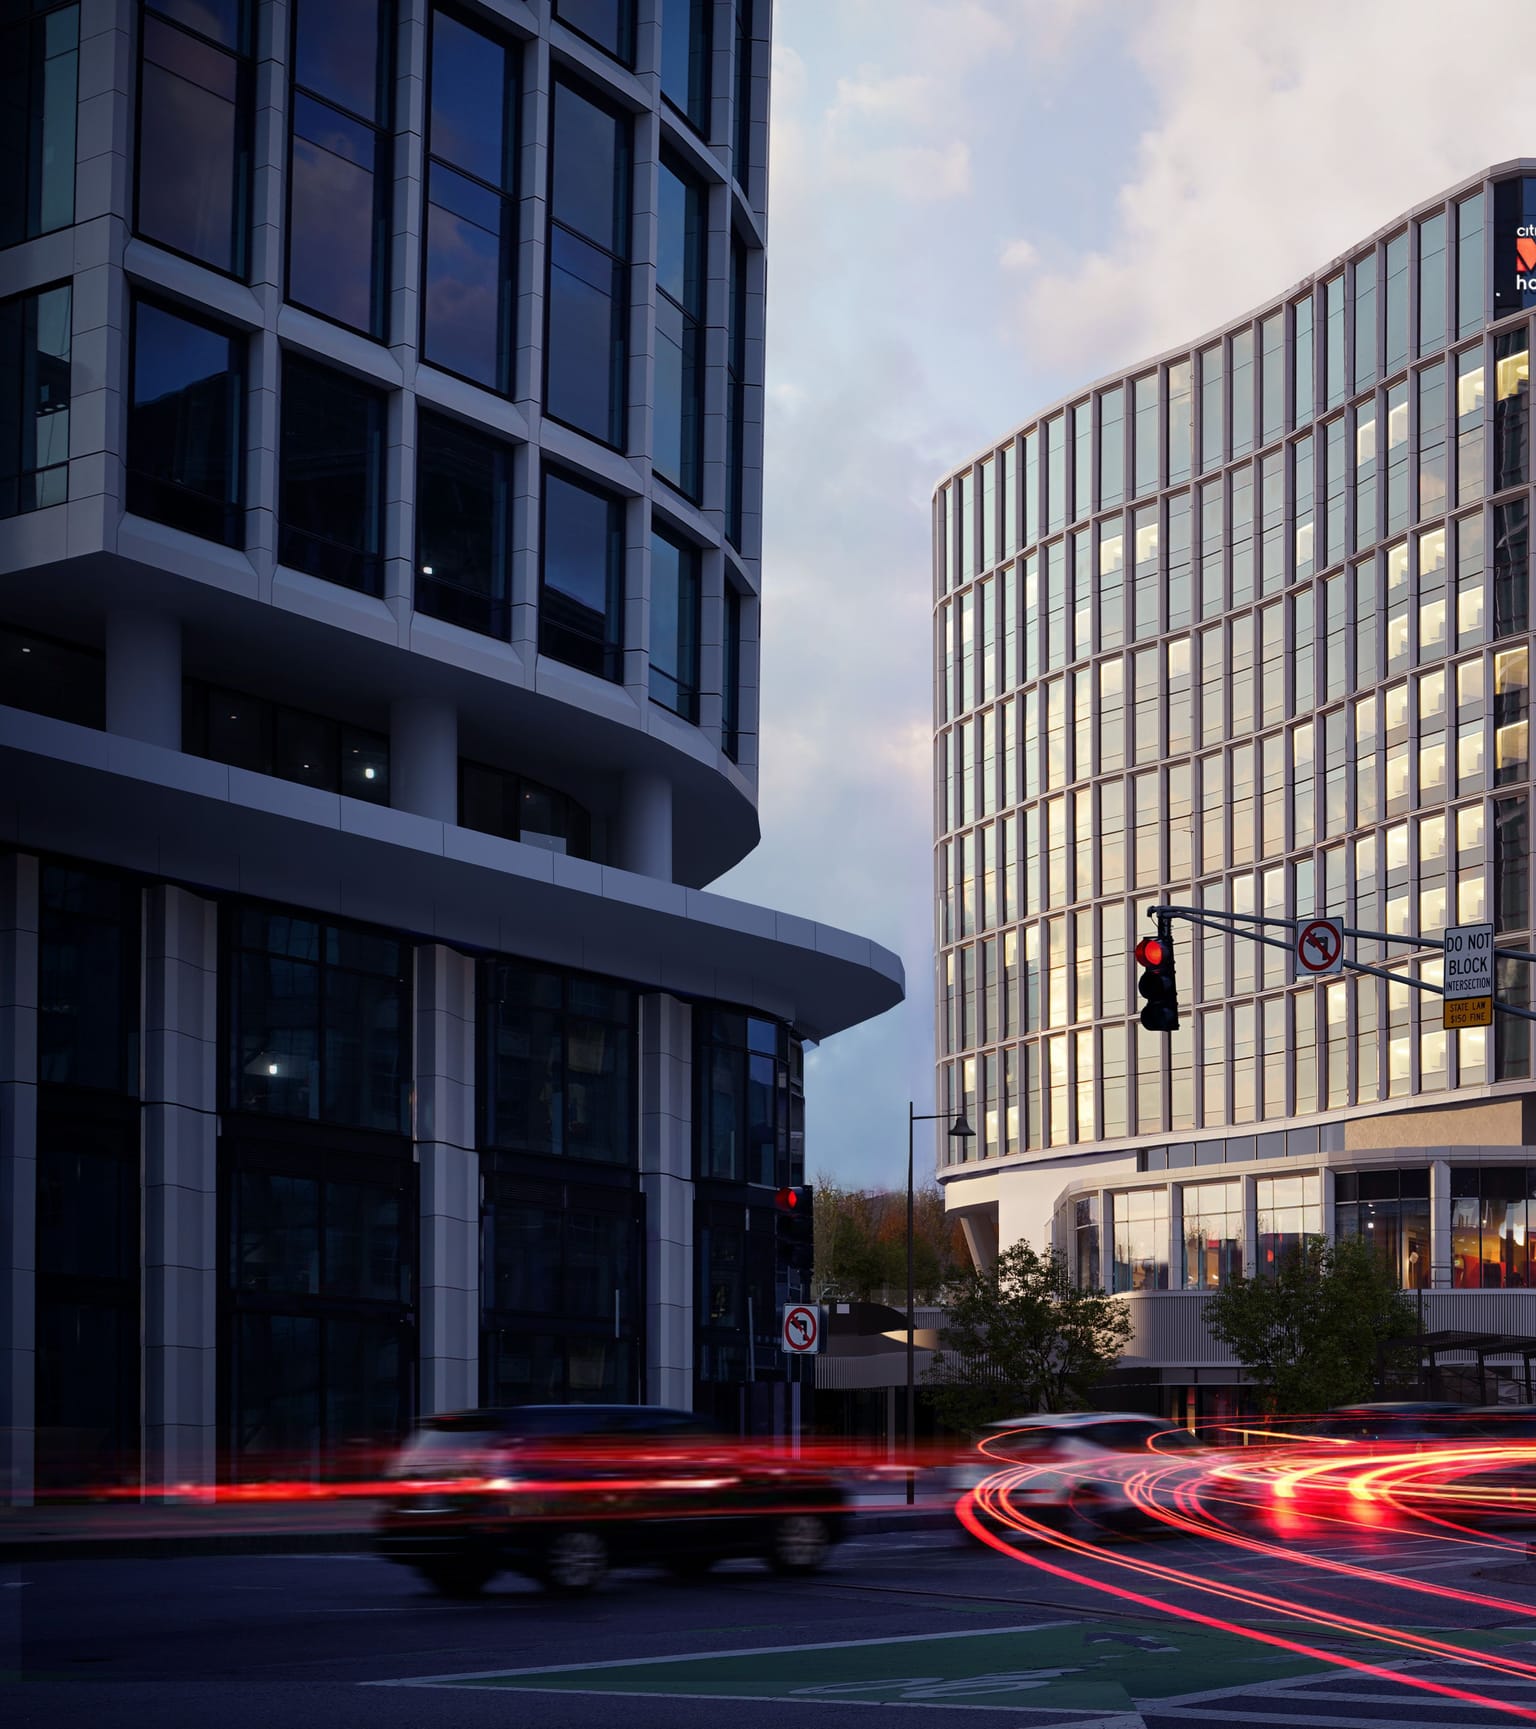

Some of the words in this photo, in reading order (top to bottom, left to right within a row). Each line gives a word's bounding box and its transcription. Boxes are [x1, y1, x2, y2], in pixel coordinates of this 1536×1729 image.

[1447, 936, 1463, 952] DO
[1468, 932, 1491, 950] NOT
[1449, 956, 1488, 976] BLOCK
[1446, 977, 1491, 992] INTERSECTION
[1450, 1002, 1469, 1012] STATE
[1472, 1001, 1486, 1011] LAW
[1470, 1012, 1485, 1021] FINE
